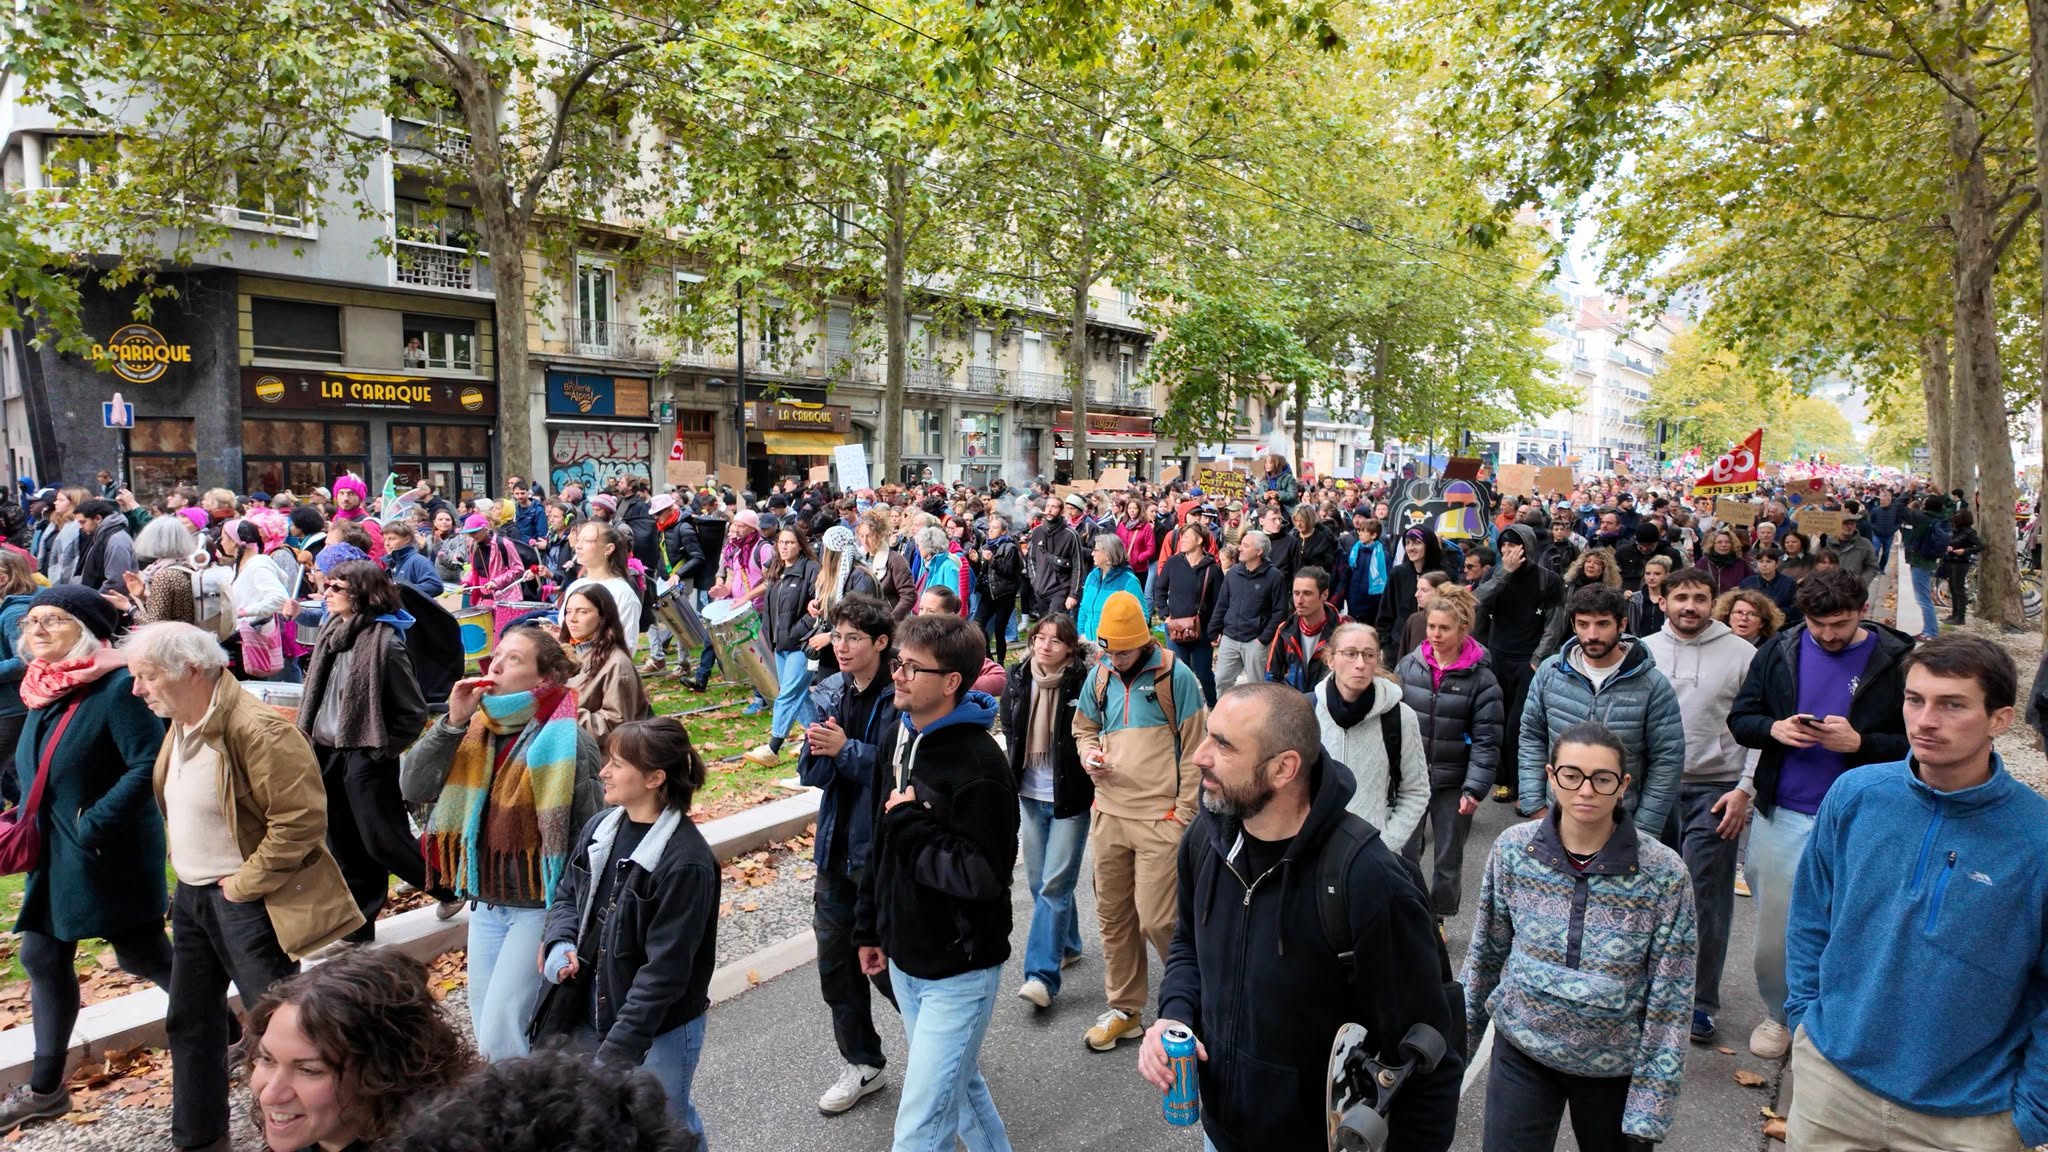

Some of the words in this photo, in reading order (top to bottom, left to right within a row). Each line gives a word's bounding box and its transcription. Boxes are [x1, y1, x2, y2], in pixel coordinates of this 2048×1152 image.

[83, 344, 103, 360] A
[109, 344, 191, 364] CARAQUE
[321, 381, 343, 398] LA
[350, 383, 432, 403] CARAQUE
[778, 409, 790, 421] LA
[792, 410, 832, 423] CARAQUE
